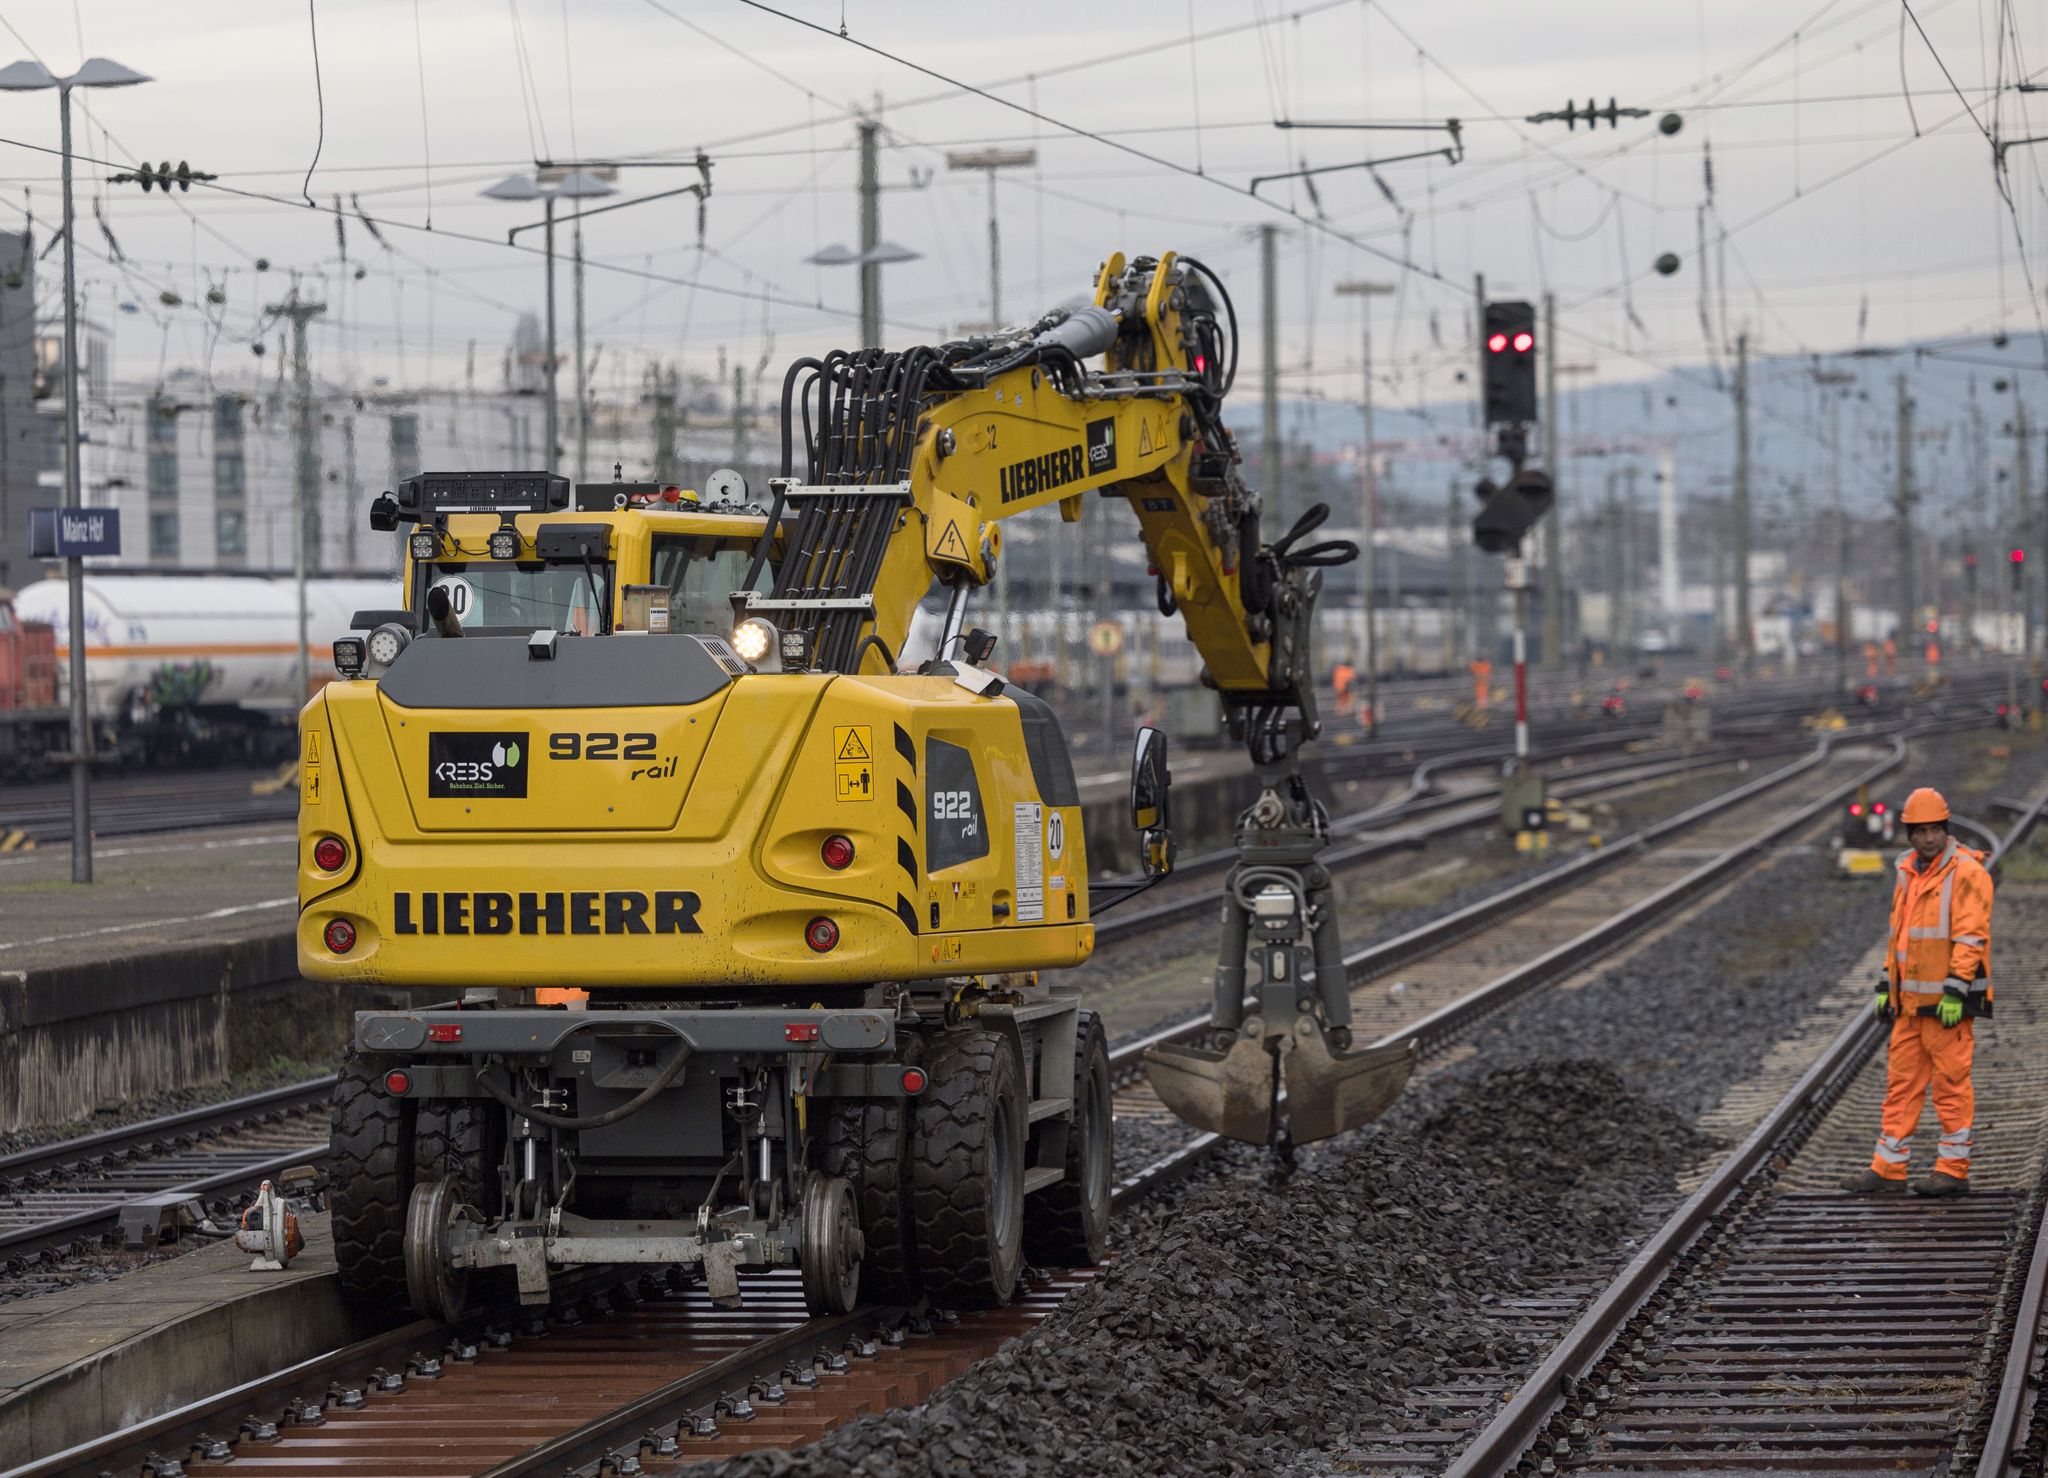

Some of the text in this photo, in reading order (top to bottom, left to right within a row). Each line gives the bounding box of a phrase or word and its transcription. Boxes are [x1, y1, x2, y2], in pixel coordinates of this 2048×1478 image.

[1000, 444, 1085, 504] LIEBHERR
[63, 516, 104, 542] Mainz Hbf
[549, 733, 657, 760] 922
[435, 762, 493, 781] KREBS
[630, 756, 678, 781] rail
[934, 791, 971, 819] 922
[961, 813, 978, 839] rail
[1050, 818, 1062, 850] 20
[394, 891, 704, 935] LIEBHERR
